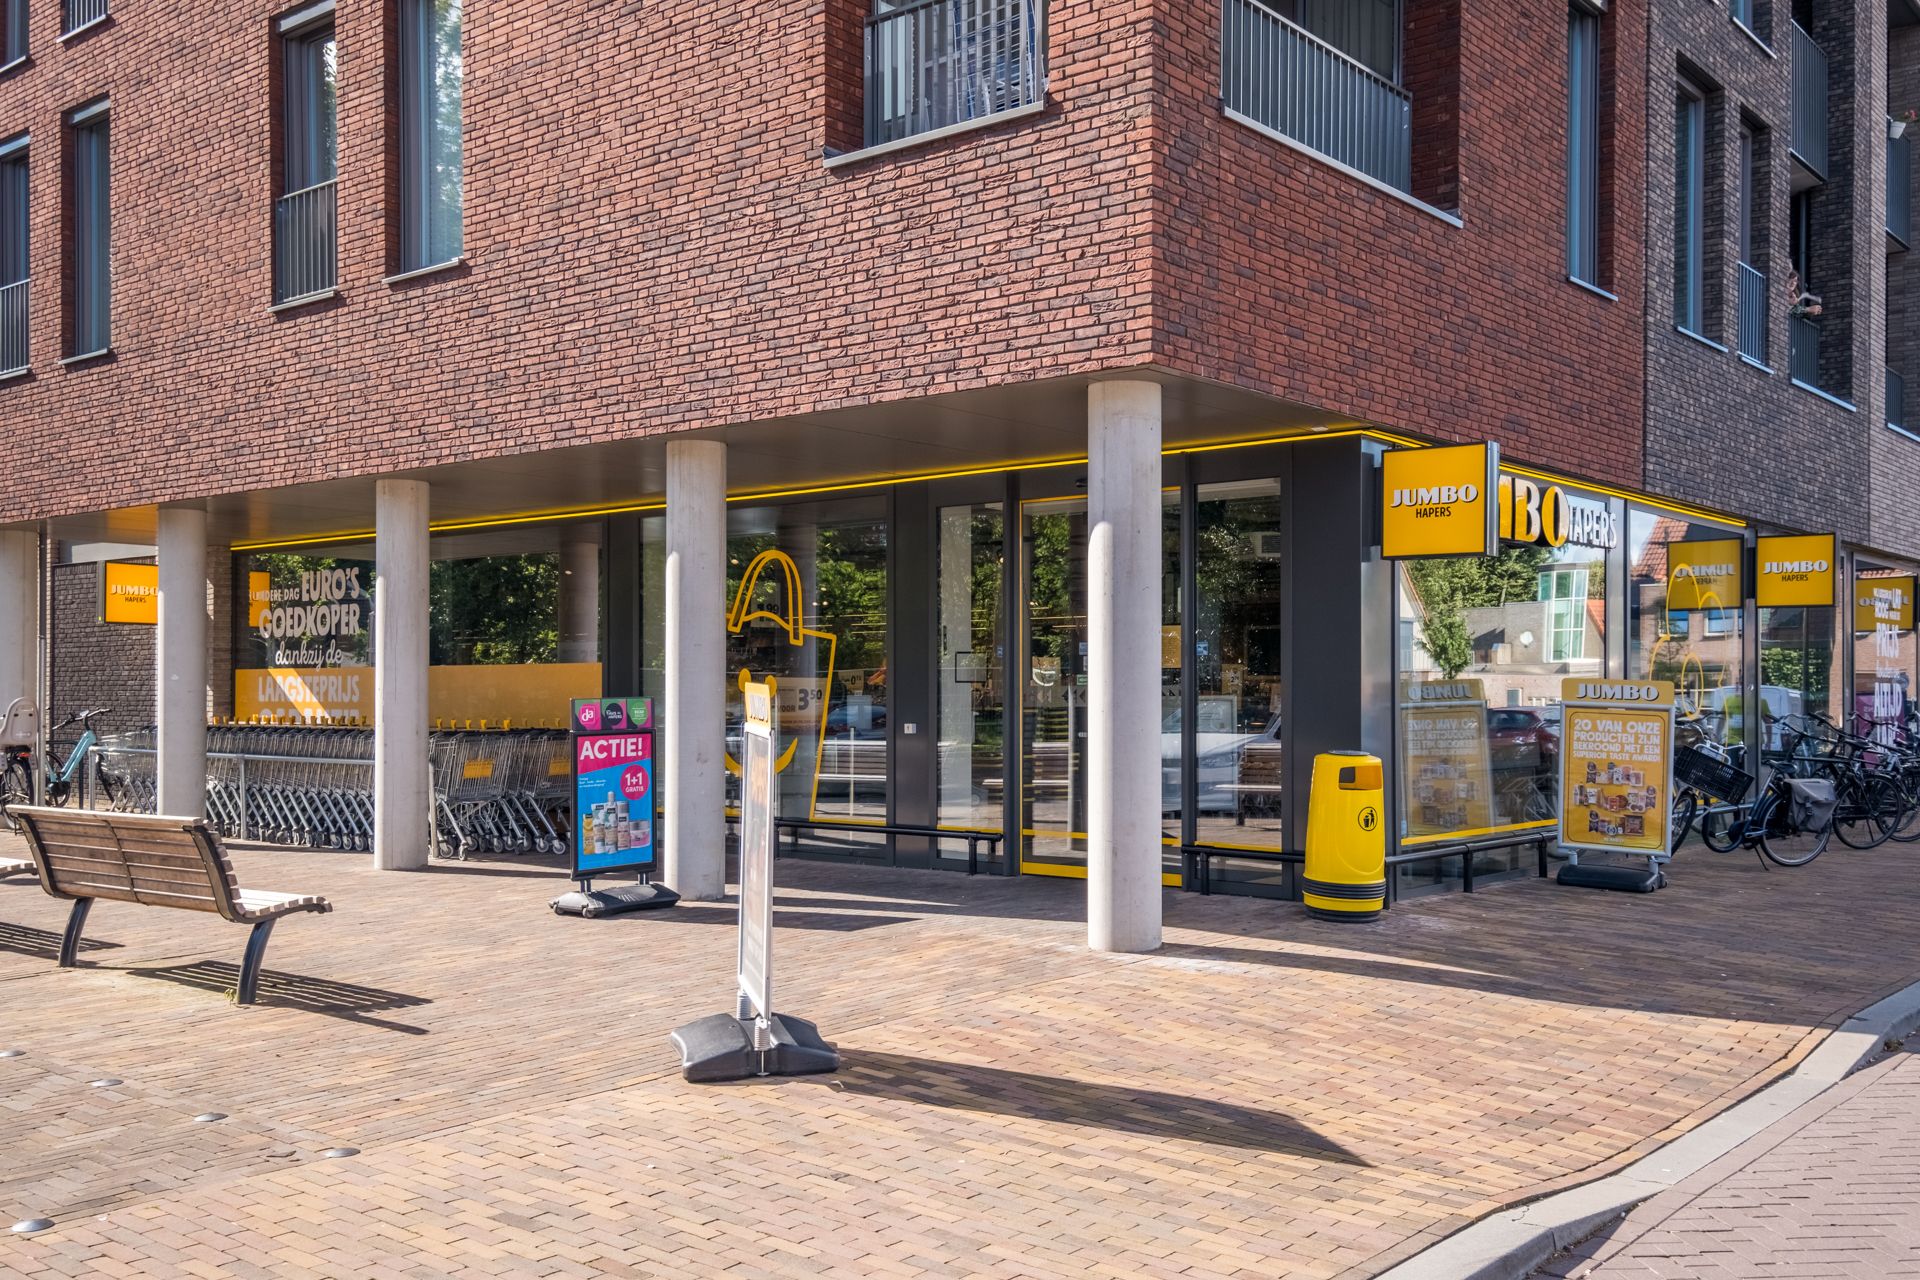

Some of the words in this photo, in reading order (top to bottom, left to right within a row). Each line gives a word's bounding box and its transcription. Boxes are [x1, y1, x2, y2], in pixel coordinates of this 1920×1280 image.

[1391, 484, 1478, 508] JUMBO
[1416, 507, 1452, 518] HAPERS
[1763, 560, 1828, 574] JUMBO
[284, 588, 300, 600] DAG
[302, 566, 360, 601] EURO'S
[1782, 574, 1808, 582] HAPERS
[258, 603, 360, 638] GOEDKOPER
[1876, 623, 1899, 658] PRIJS
[276, 641, 324, 671] dankzij
[326, 639, 343, 665] de
[258, 675, 360, 702] LAAGSTEPRIJS
[1577, 684, 1659, 701] JUMBO
[1874, 683, 1902, 717] ALTIJD
[582, 709, 594, 721] da
[1574, 720, 1591, 731] 20
[1596, 720, 1622, 732] VAN
[1627, 722, 1661, 734] ONZE
[1574, 731, 1634, 743] PRODUCTEN
[1638, 734, 1660, 744] ZIJN
[580, 738, 642, 760] ACTIE!
[1574, 741, 1621, 752] BEKROOND
[1624, 744, 1640, 753] MET
[1644, 745, 1660, 754] EEN
[1573, 751, 1607, 759] SUPERIOR
[1610, 752, 1630, 760] TASTE
[625, 772, 642, 786] 1+1
